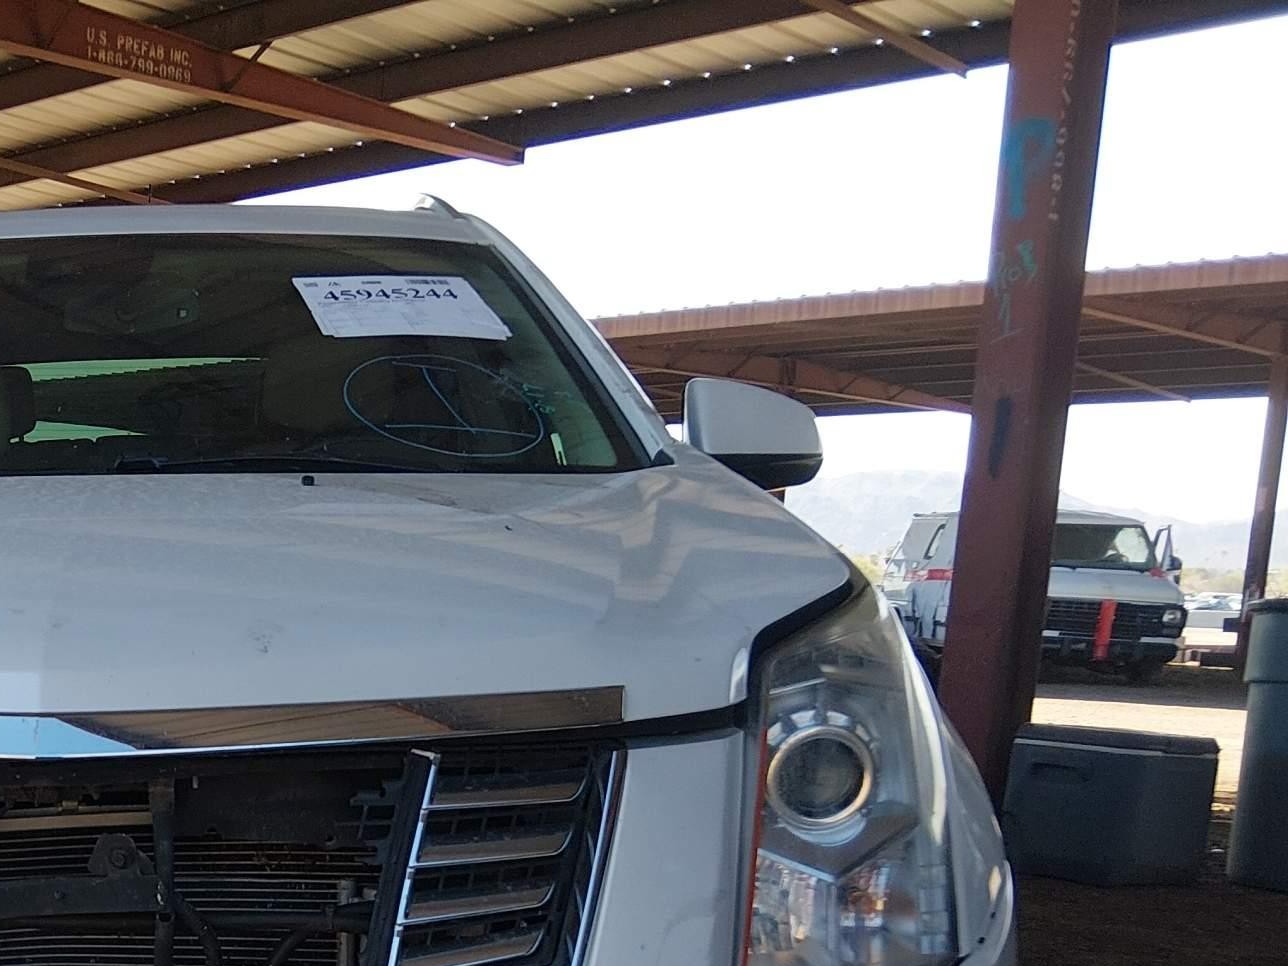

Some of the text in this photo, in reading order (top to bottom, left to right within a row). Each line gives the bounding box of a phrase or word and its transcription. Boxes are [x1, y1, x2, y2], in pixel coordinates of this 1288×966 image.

[117, 34, 165, 60] PREFAB
[170, 47, 192, 68] INC.
[323, 287, 459, 301] 45945244
